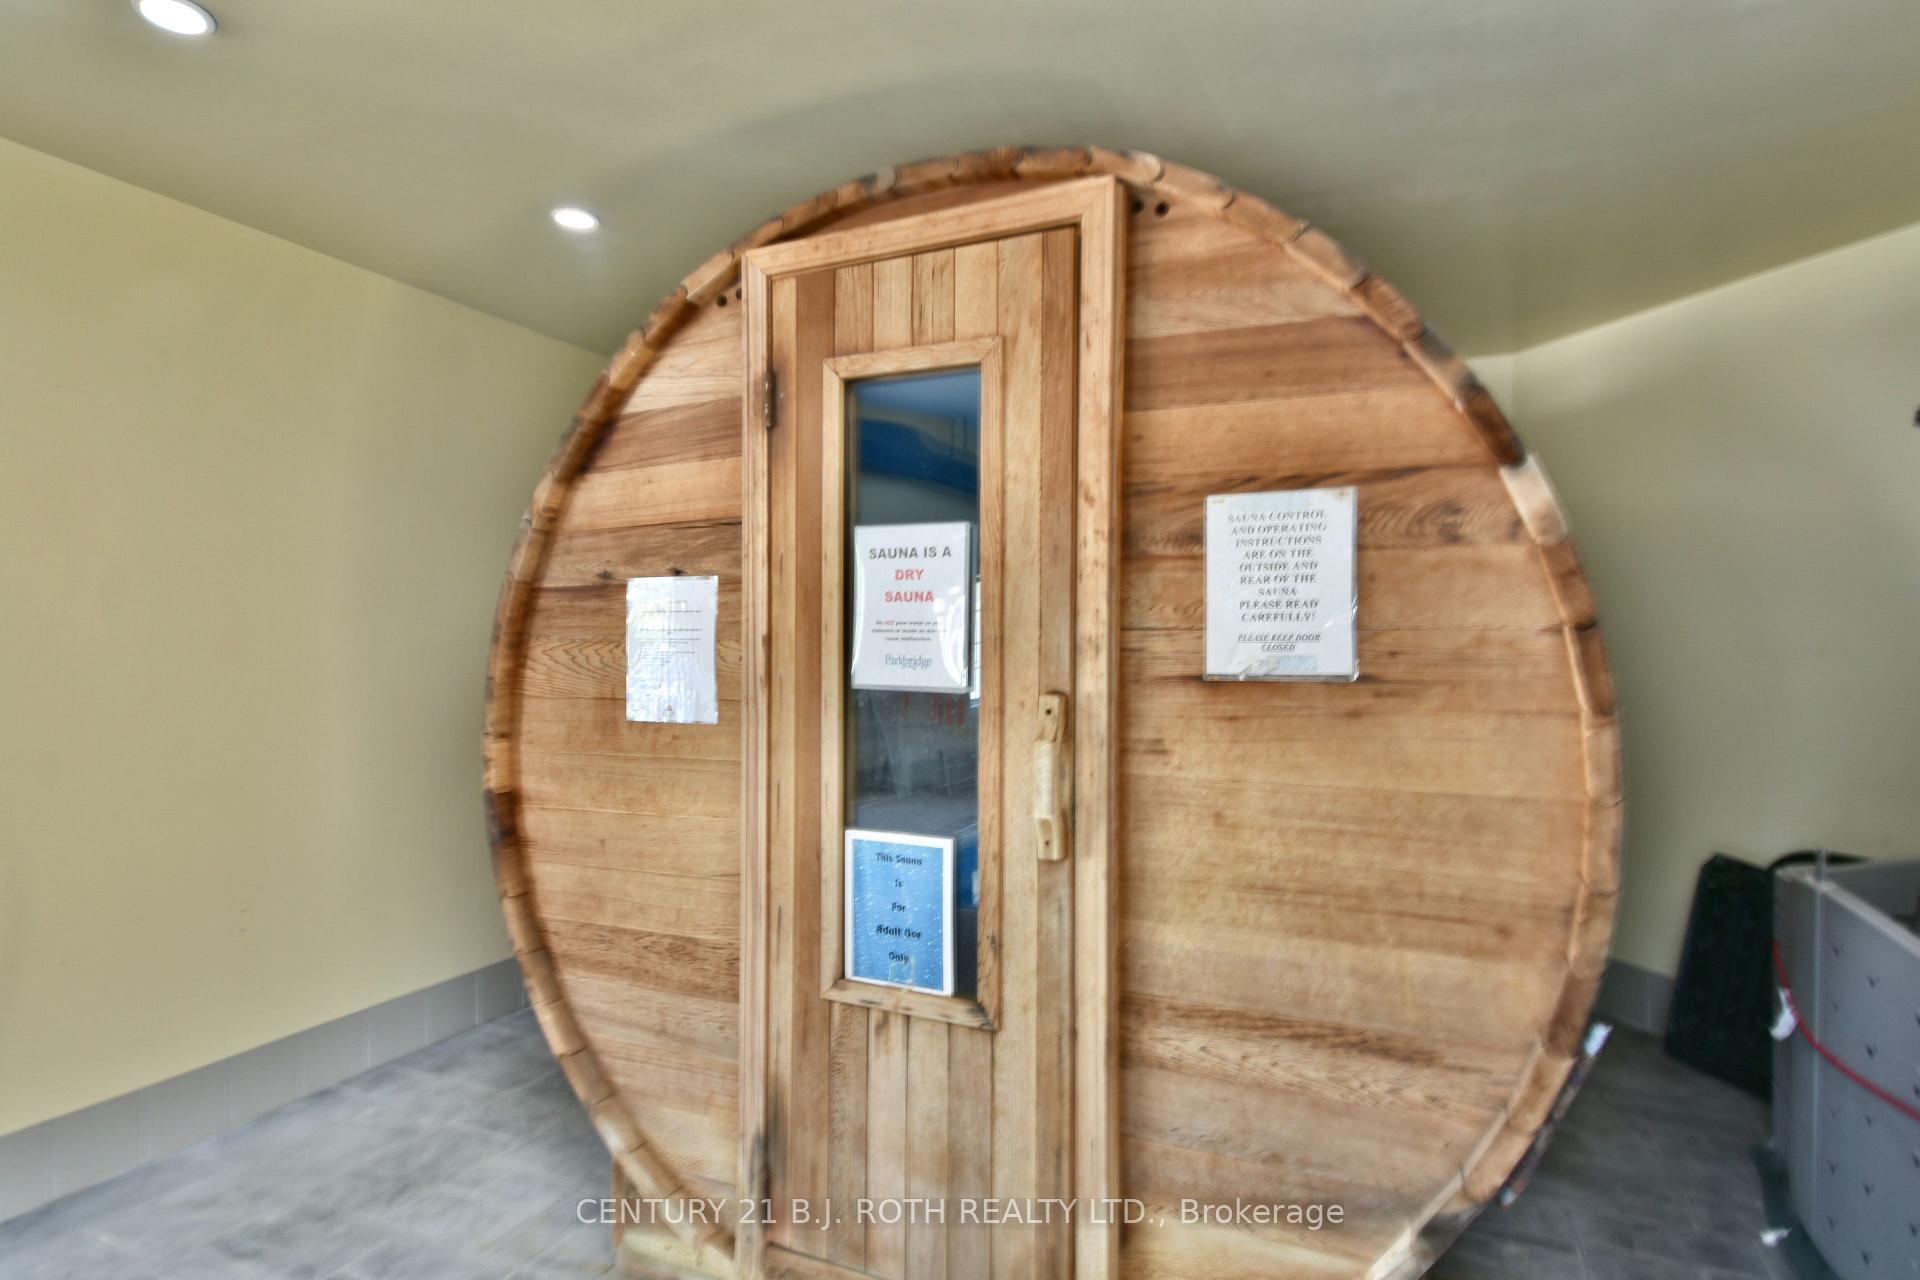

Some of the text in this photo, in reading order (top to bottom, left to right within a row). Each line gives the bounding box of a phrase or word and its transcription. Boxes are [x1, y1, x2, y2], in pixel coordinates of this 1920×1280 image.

[1228, 510, 1328, 523] SAUNA CONTROL
[1231, 522, 1327, 536] AND OPERATING
[1236, 535, 1322, 547] INSTRUCTIONS
[869, 546, 952, 560] SAUNA IS A
[1243, 548, 1313, 560] ARE ON THE
[1239, 560, 1318, 572] OUTSIDE AND
[895, 569, 924, 581] DRY
[1240, 574, 1316, 585] REAR OF THE
[885, 591, 934, 603] SAUNA
[1259, 587, 1297, 596] SAUNA
[1240, 599, 1319, 609] PLEASE READ
[1241, 612, 1316, 622] CAREFULLY!
[1238, 632, 1321, 642] PLEASE KEEP DOOR
[1261, 643, 1296, 652] CLOSED
[885, 654, 932, 670] Parkbridge
[876, 852, 922, 866] This Sauna
[891, 902, 906, 913] For
[876, 924, 921, 939] Adult Use
[888, 951, 909, 965] Only
